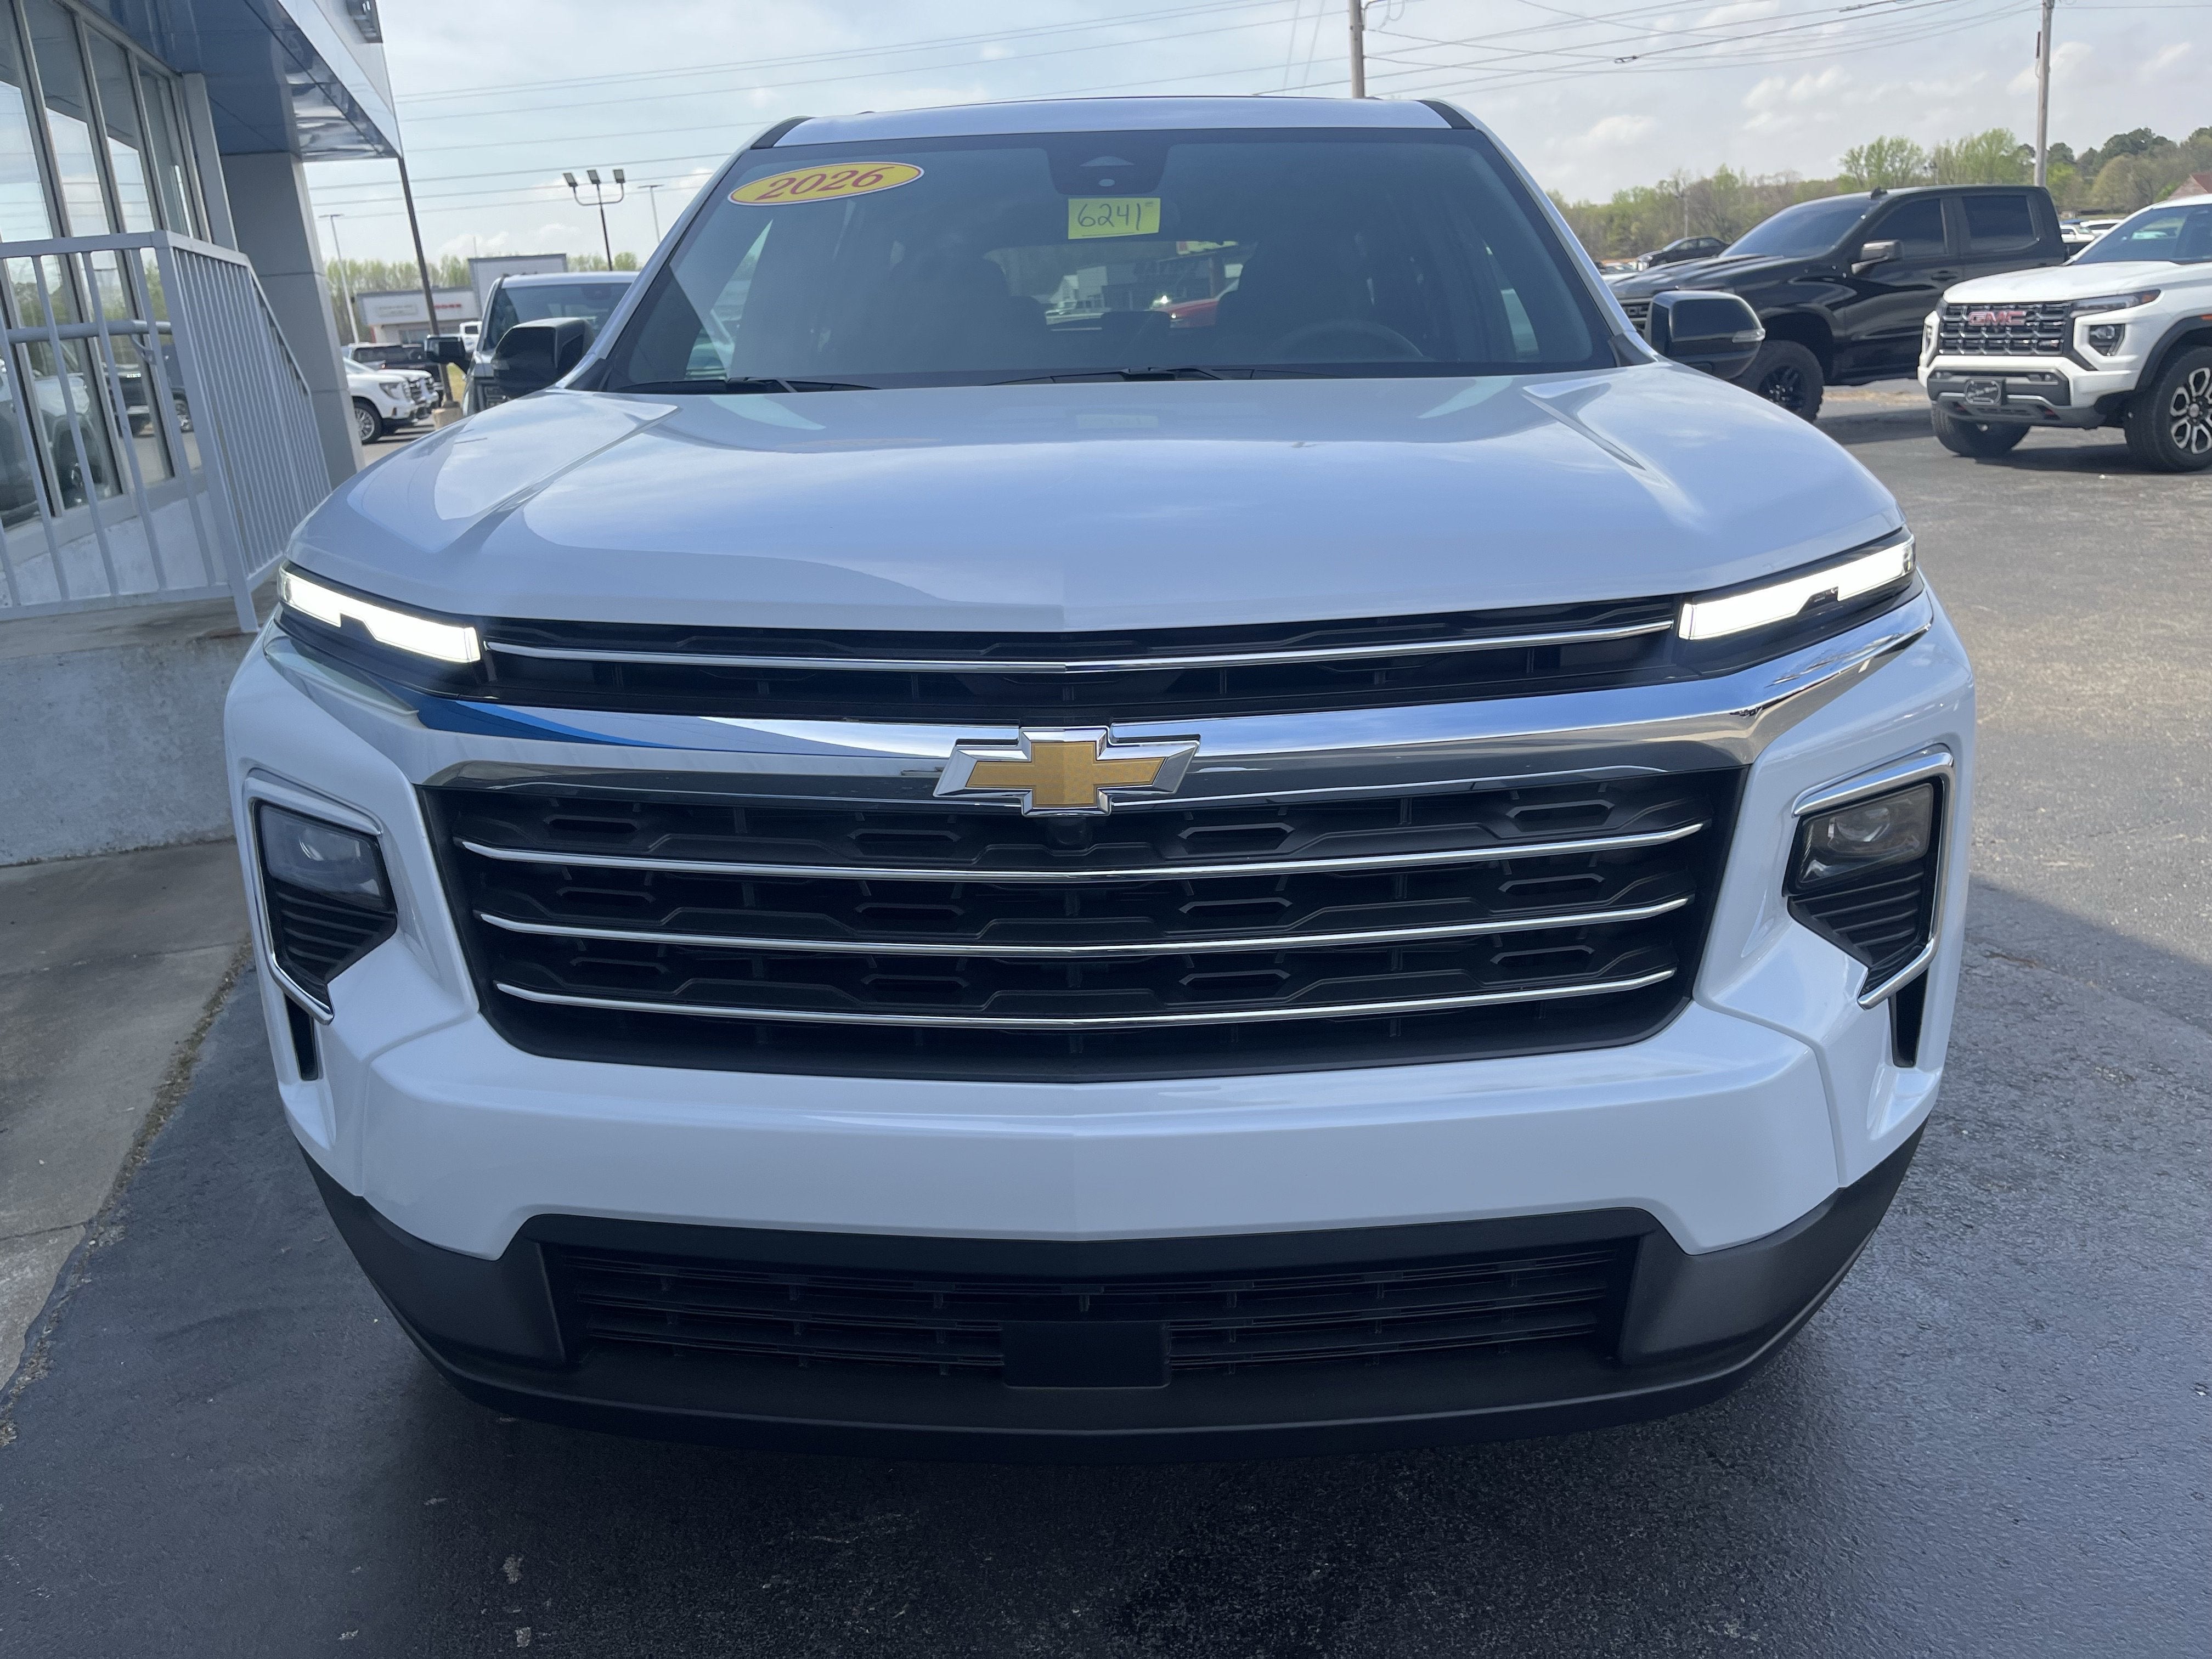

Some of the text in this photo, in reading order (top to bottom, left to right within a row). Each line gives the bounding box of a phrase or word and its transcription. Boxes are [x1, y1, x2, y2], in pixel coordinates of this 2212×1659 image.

[754, 166, 896, 201] 2026
[1077, 202, 1141, 231] 6241
[1968, 311, 2027, 326] GMC
